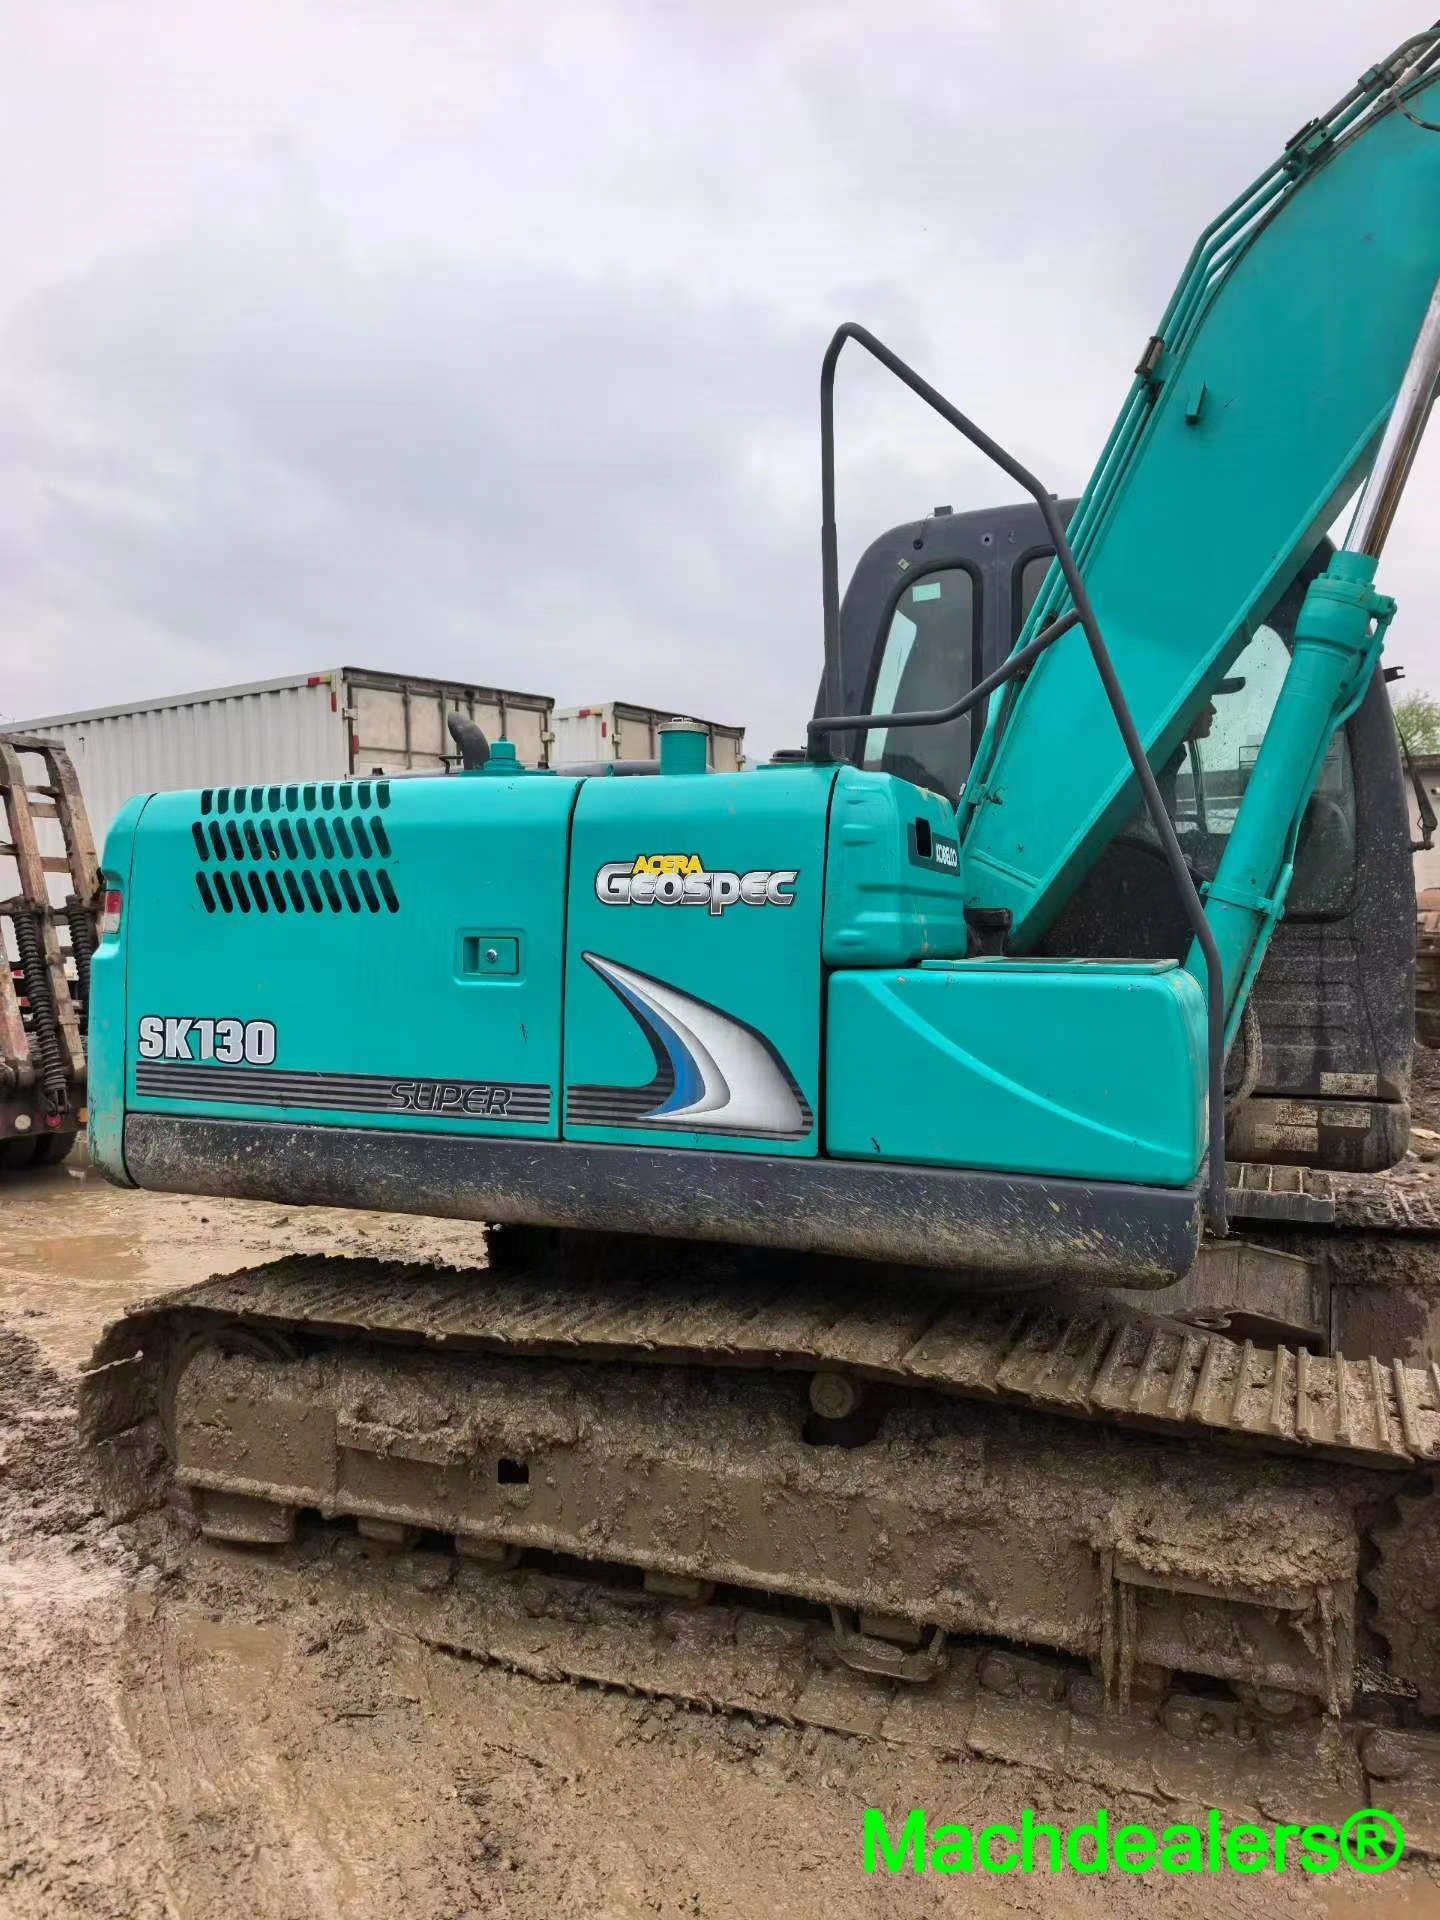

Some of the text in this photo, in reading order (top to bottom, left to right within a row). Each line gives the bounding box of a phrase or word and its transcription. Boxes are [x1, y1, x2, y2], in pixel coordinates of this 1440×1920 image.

[632, 855, 703, 875] ACERA
[138, 1015, 276, 1065] SK130
[387, 1082, 513, 1117] SUPER
